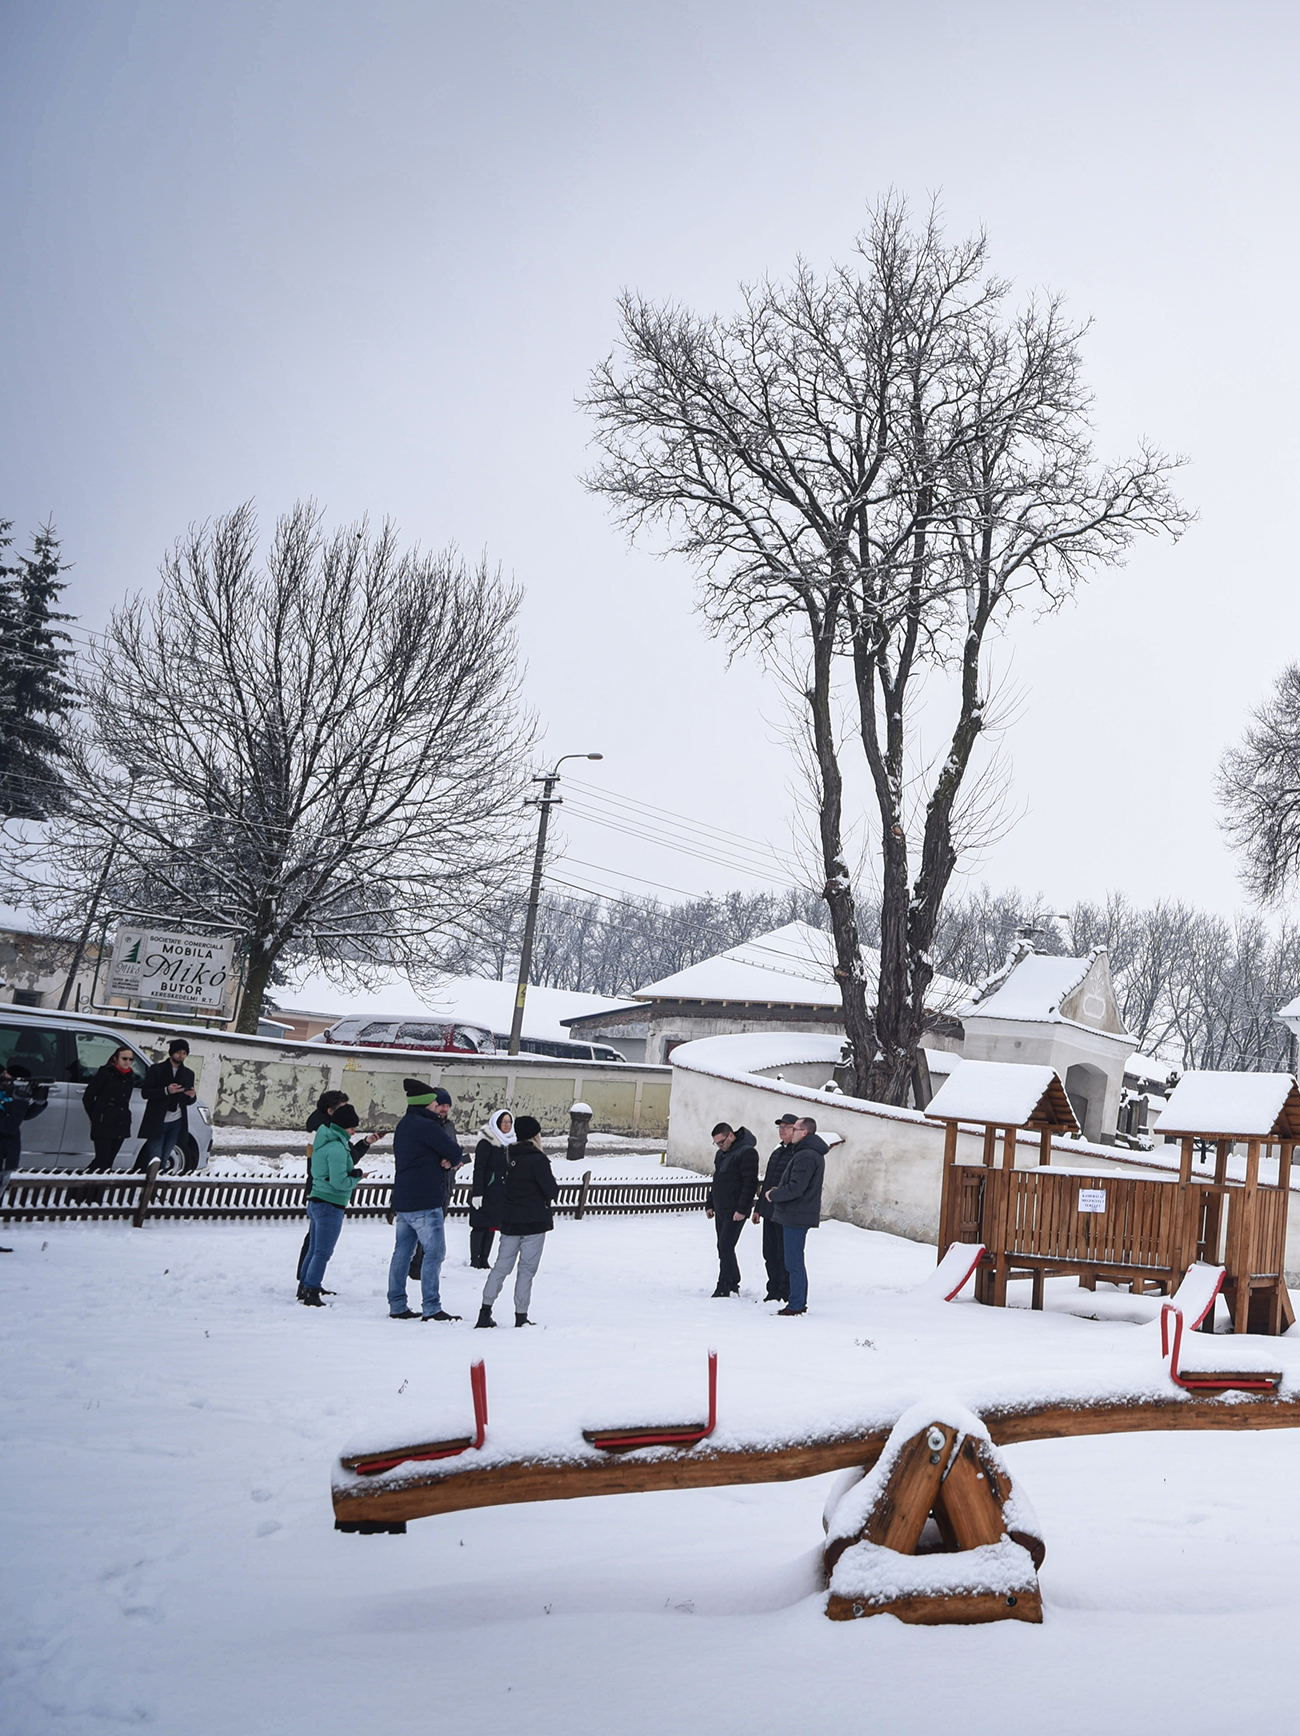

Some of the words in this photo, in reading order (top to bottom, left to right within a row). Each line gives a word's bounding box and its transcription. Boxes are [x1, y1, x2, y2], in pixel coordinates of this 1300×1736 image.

[150, 935, 182, 945] SOCIETATE
[162, 944, 213, 959] MOBILA
[143, 953, 227, 987] Mikó
[160, 982, 202, 996] BUTOR
[151, 992, 198, 1002] KERESKEDELMI
